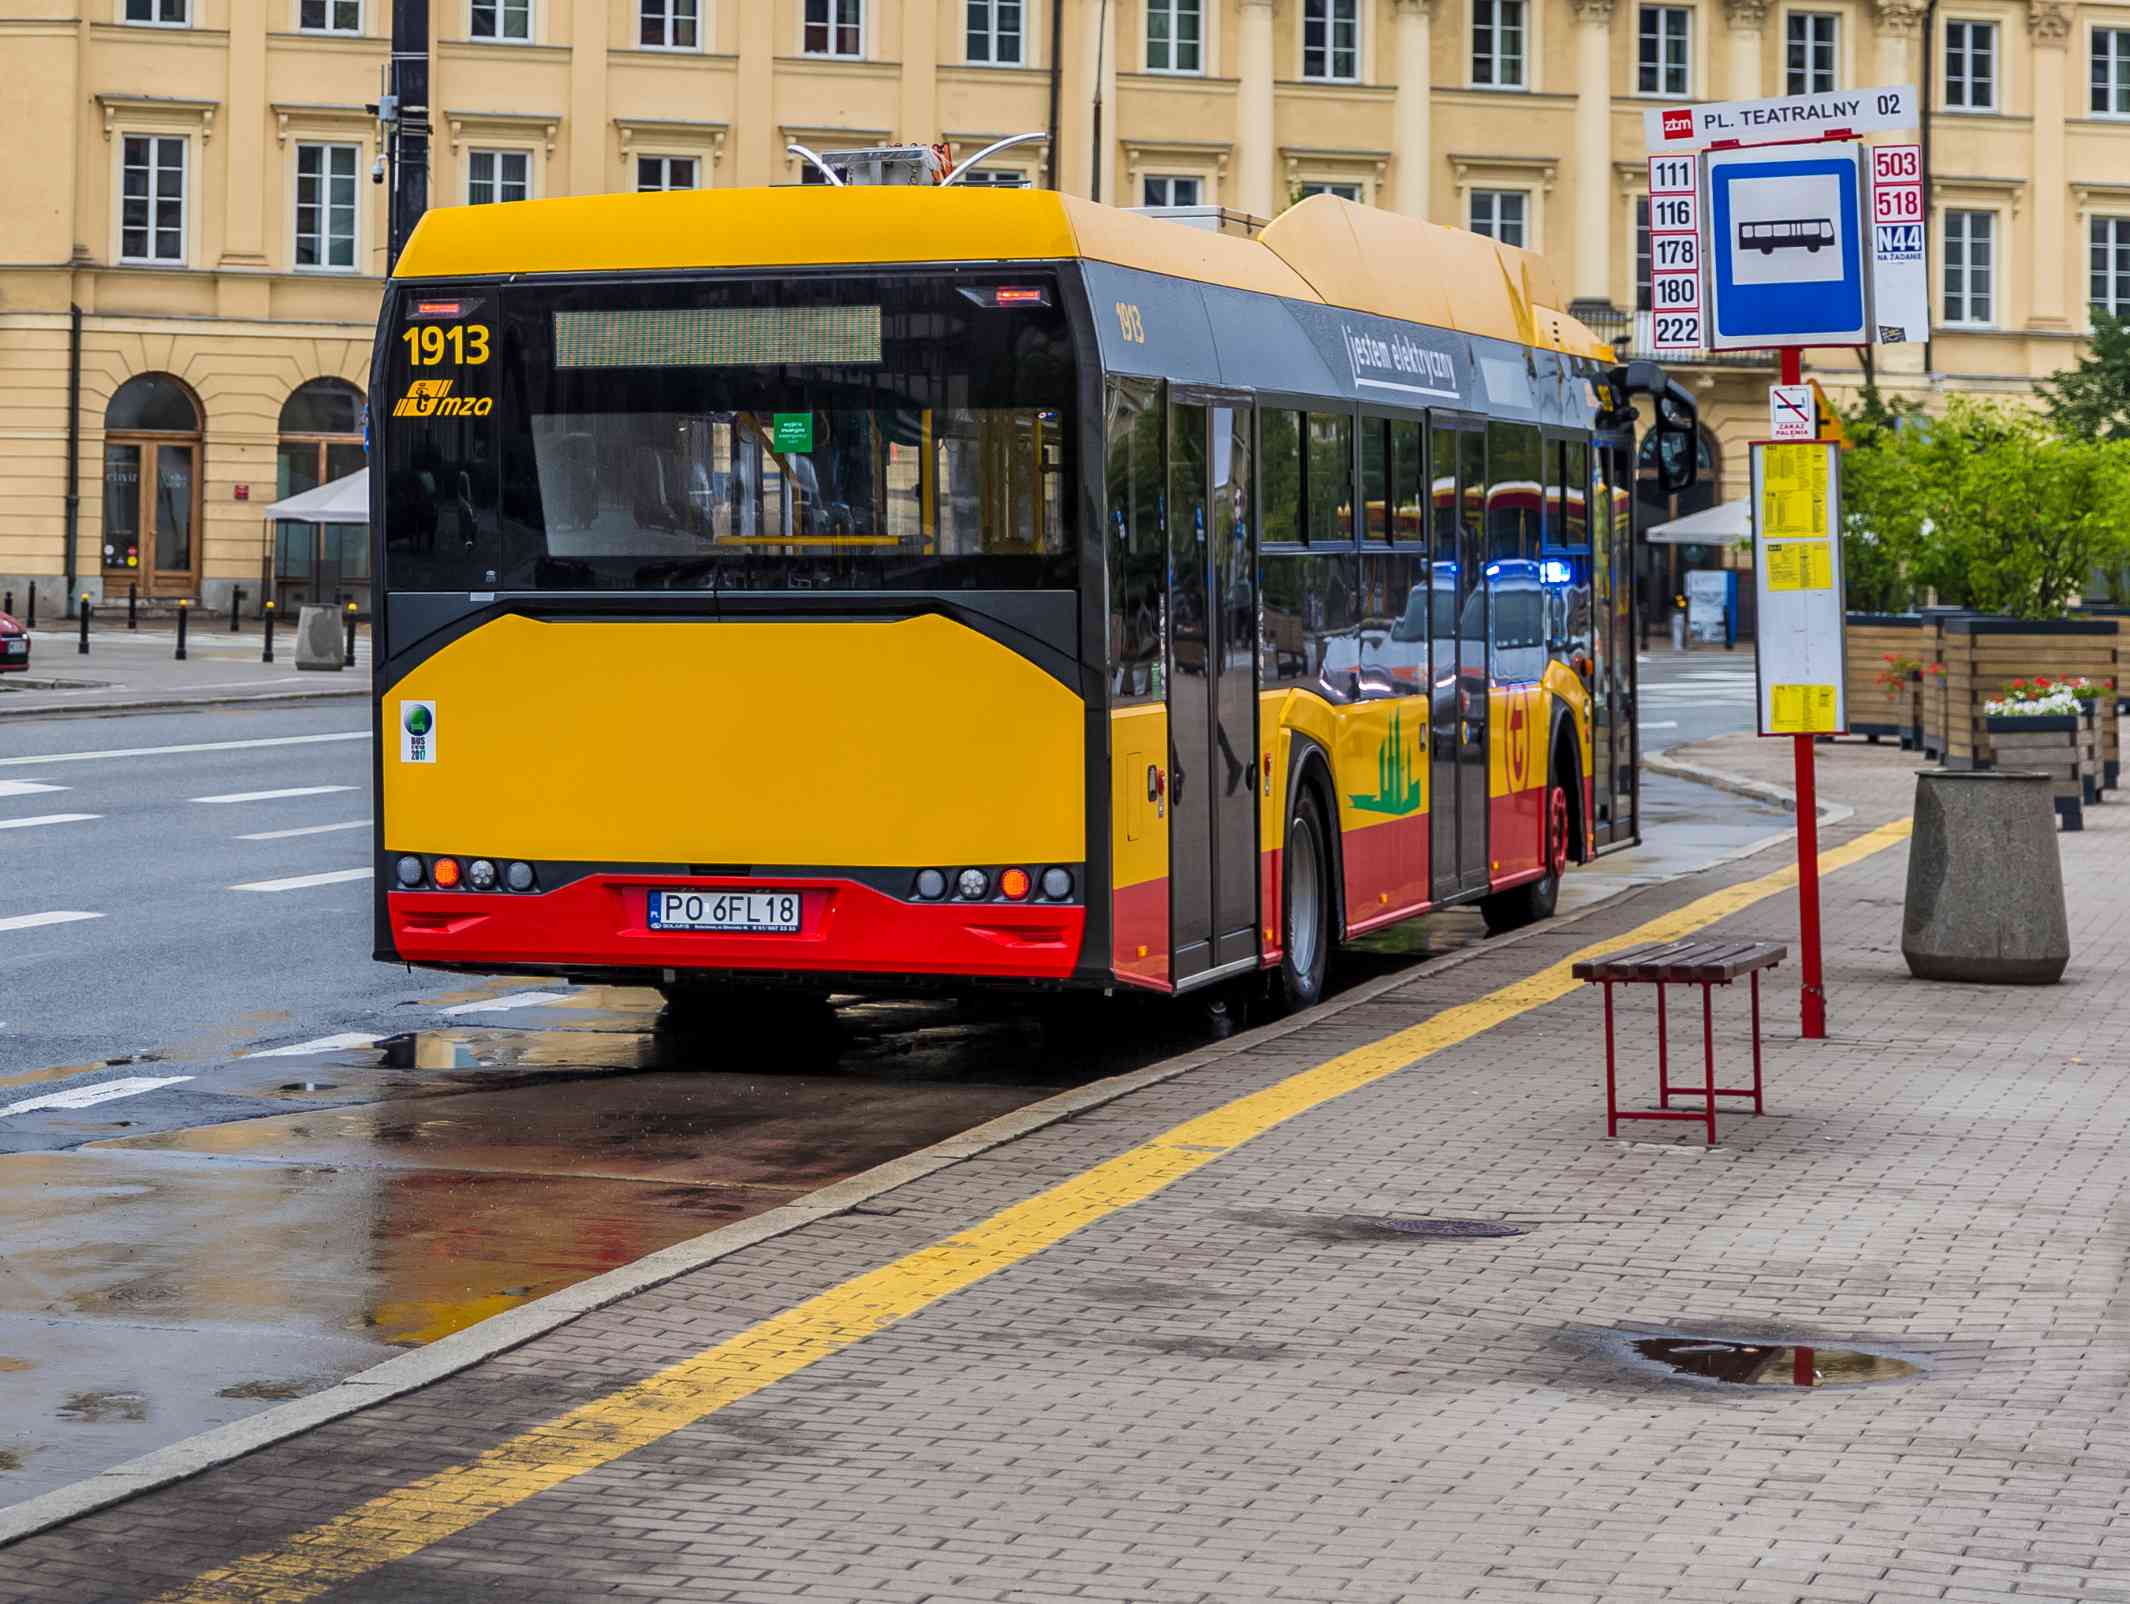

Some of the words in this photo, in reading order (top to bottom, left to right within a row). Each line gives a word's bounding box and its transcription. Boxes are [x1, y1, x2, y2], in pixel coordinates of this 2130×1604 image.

[1704, 114, 1734, 129] PL.
[1740, 100, 1860, 126] TEATRALNY
[1877, 94, 1901, 115] 02
[1664, 118, 1692, 131] ztm
[1656, 162, 1689, 186] 111
[1877, 152, 1917, 177] 503
[1656, 201, 1690, 225] 116
[1878, 191, 1918, 216] 518
[1877, 225, 1921, 251] N44
[1657, 240, 1694, 264] 178
[1657, 279, 1695, 303] 180
[1114, 302, 1145, 344] 1913
[1657, 318, 1699, 342] 222
[402, 324, 490, 366] 1913
[1346, 325, 1392, 374] jestem
[1391, 333, 1457, 390] elektryczny
[436, 396, 493, 416] mza
[411, 750, 426, 761] 2017
[665, 895, 703, 921] PO
[713, 896, 795, 922] 6FL18
